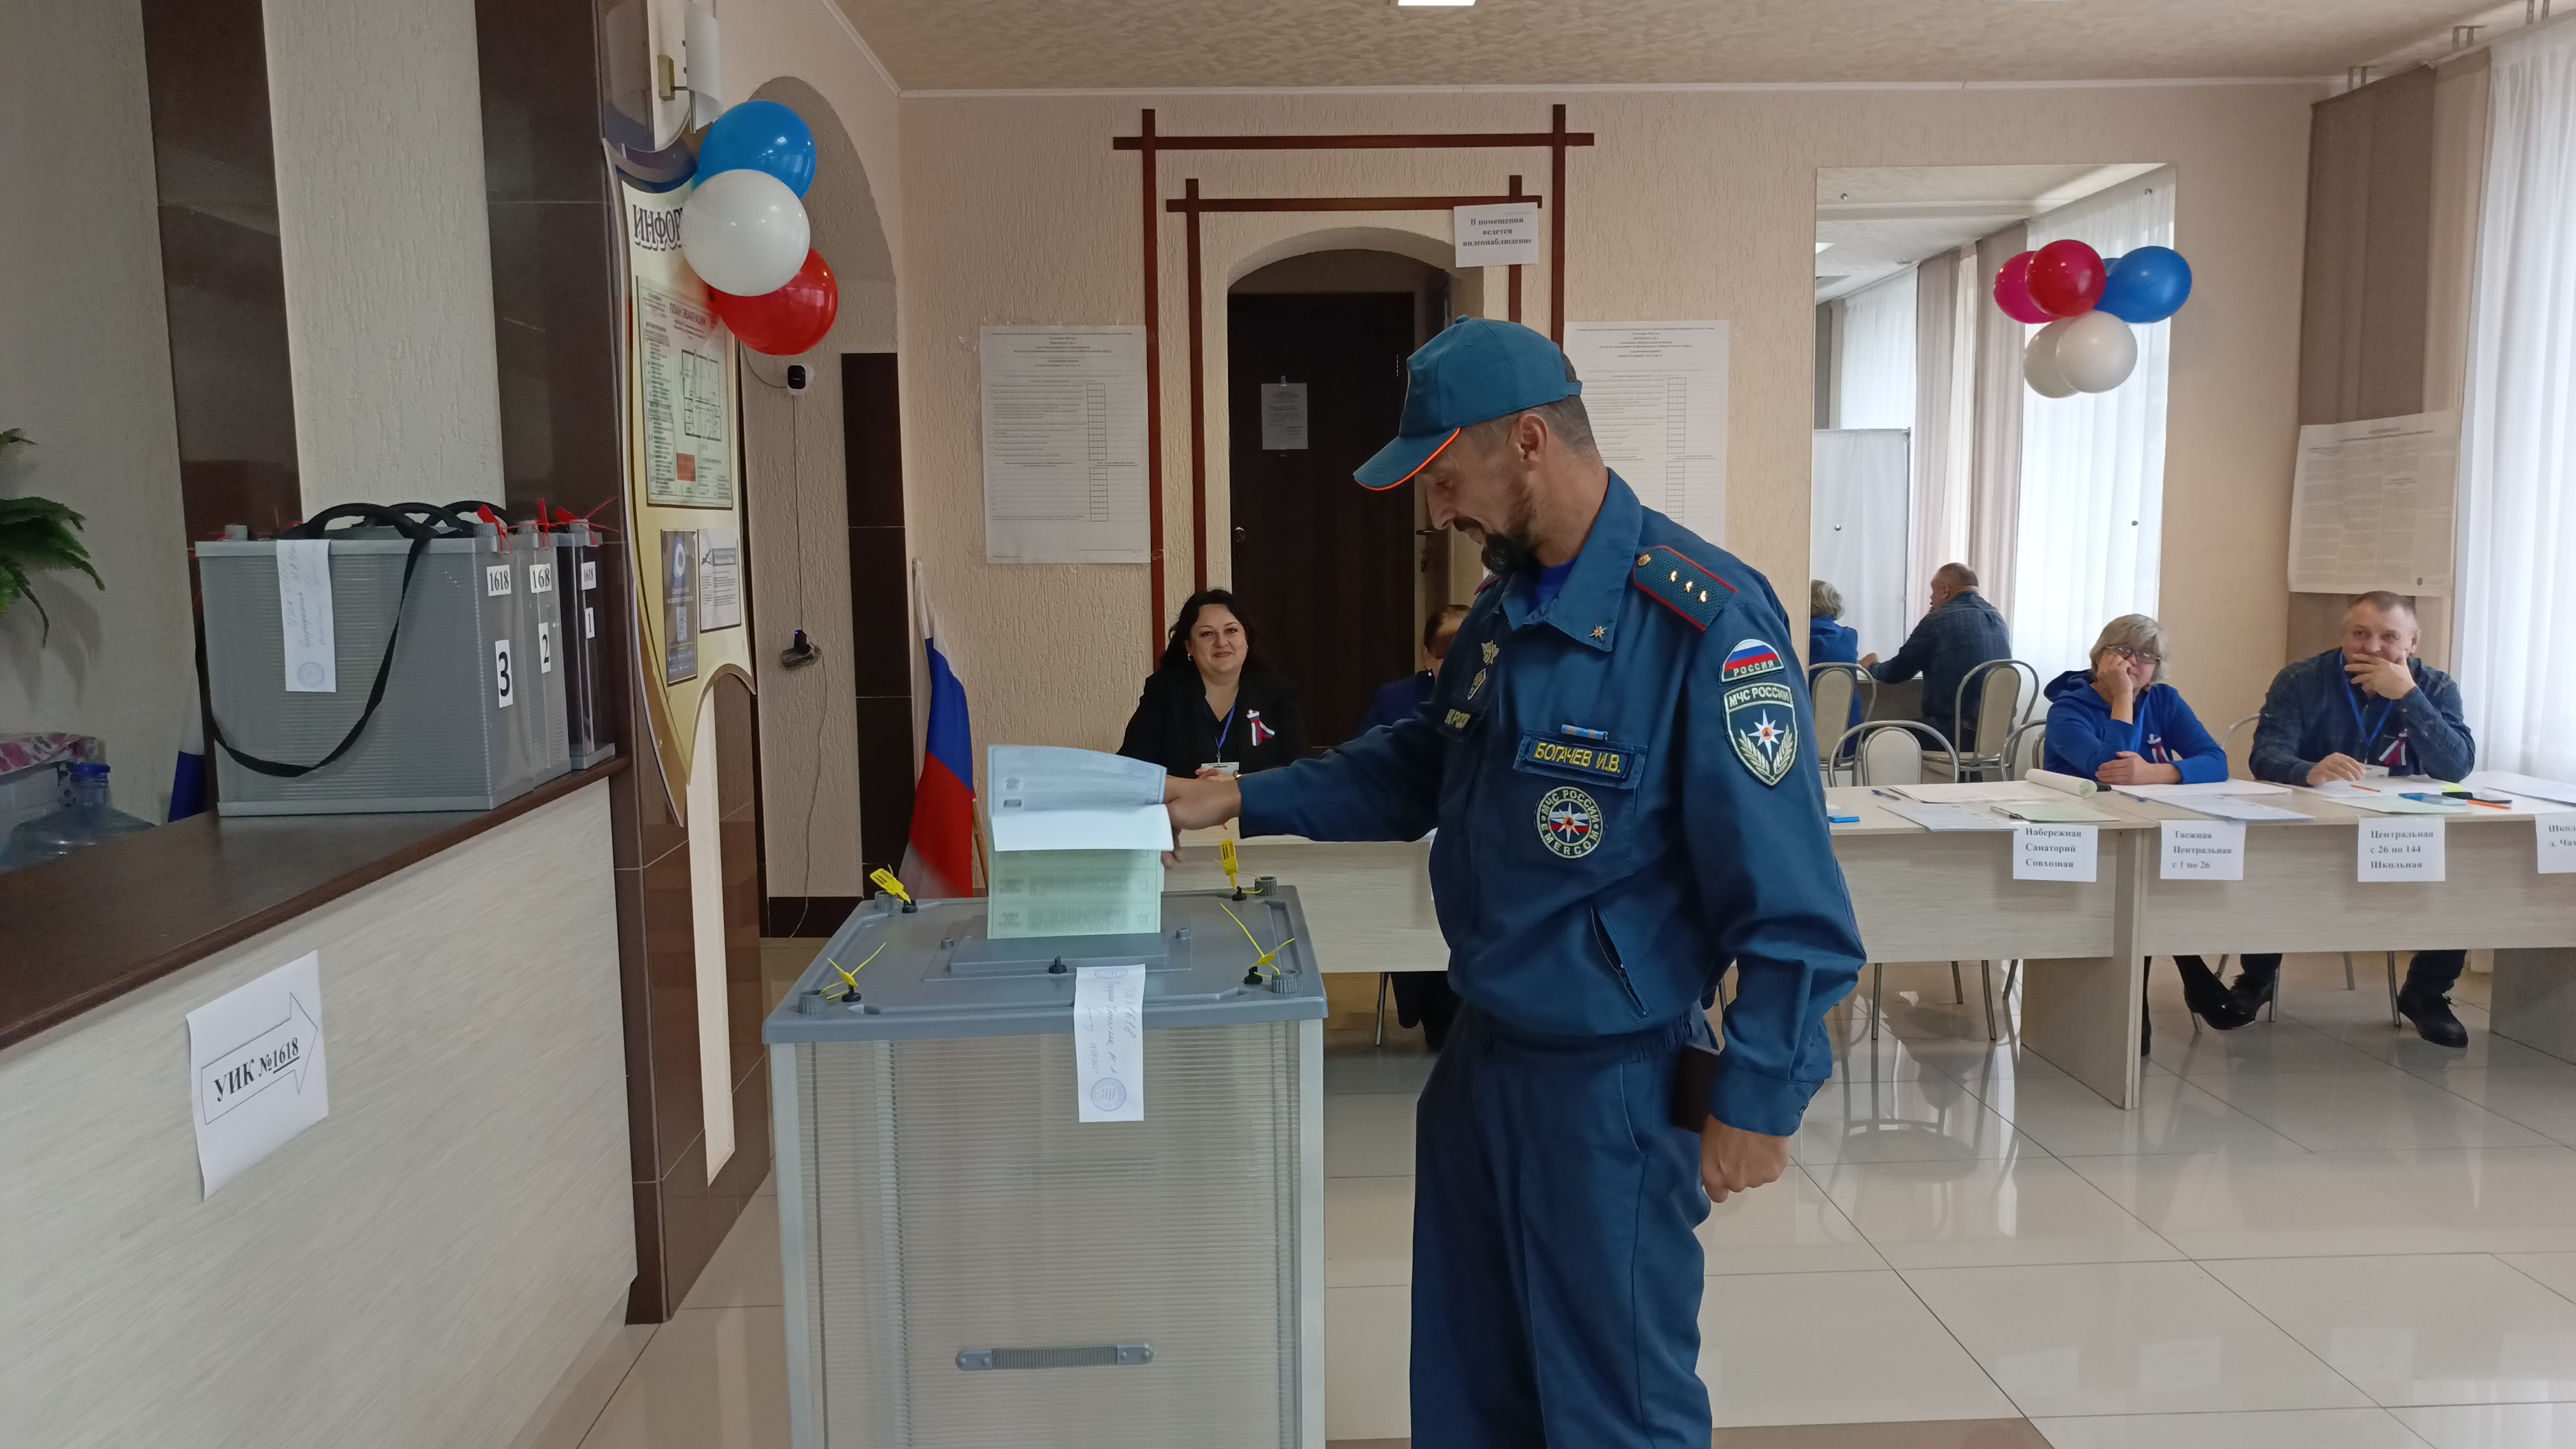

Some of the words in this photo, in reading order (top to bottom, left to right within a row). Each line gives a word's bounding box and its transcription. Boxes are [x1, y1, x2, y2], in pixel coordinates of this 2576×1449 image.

[633, 204, 683, 247] ИНФОР
[1463, 238, 1532, 247] видеонаблюдение
[489, 570, 509, 591] 1618
[584, 567, 594, 583] 1618
[588, 612, 593, 633] 1
[542, 633, 550, 664] 2
[498, 651, 510, 697] 3
[1733, 660, 1774, 677] РОССИЯ
[1729, 689, 1751, 707] МЧС
[1751, 686, 1789, 702] РОССИИ
[1533, 742, 1593, 768] БОГАЧЕВ
[1595, 752, 1621, 774] И.В.
[1541, 793, 1560, 816] МЧС
[1562, 789, 1600, 823] РОССИИ
[1541, 823, 1599, 855] EMERCOM
[2025, 828, 2081, 838] Набережная
[2371, 831, 2433, 840] Центральная
[2025, 843, 2076, 854] Санаторий
[2174, 846, 2232, 856] Центральная
[2378, 845, 2389, 854] 26
[2025, 858, 2073, 868] Совхозная
[214, 1058, 255, 1102] УИК
[258, 1036, 300, 1078] №1618
